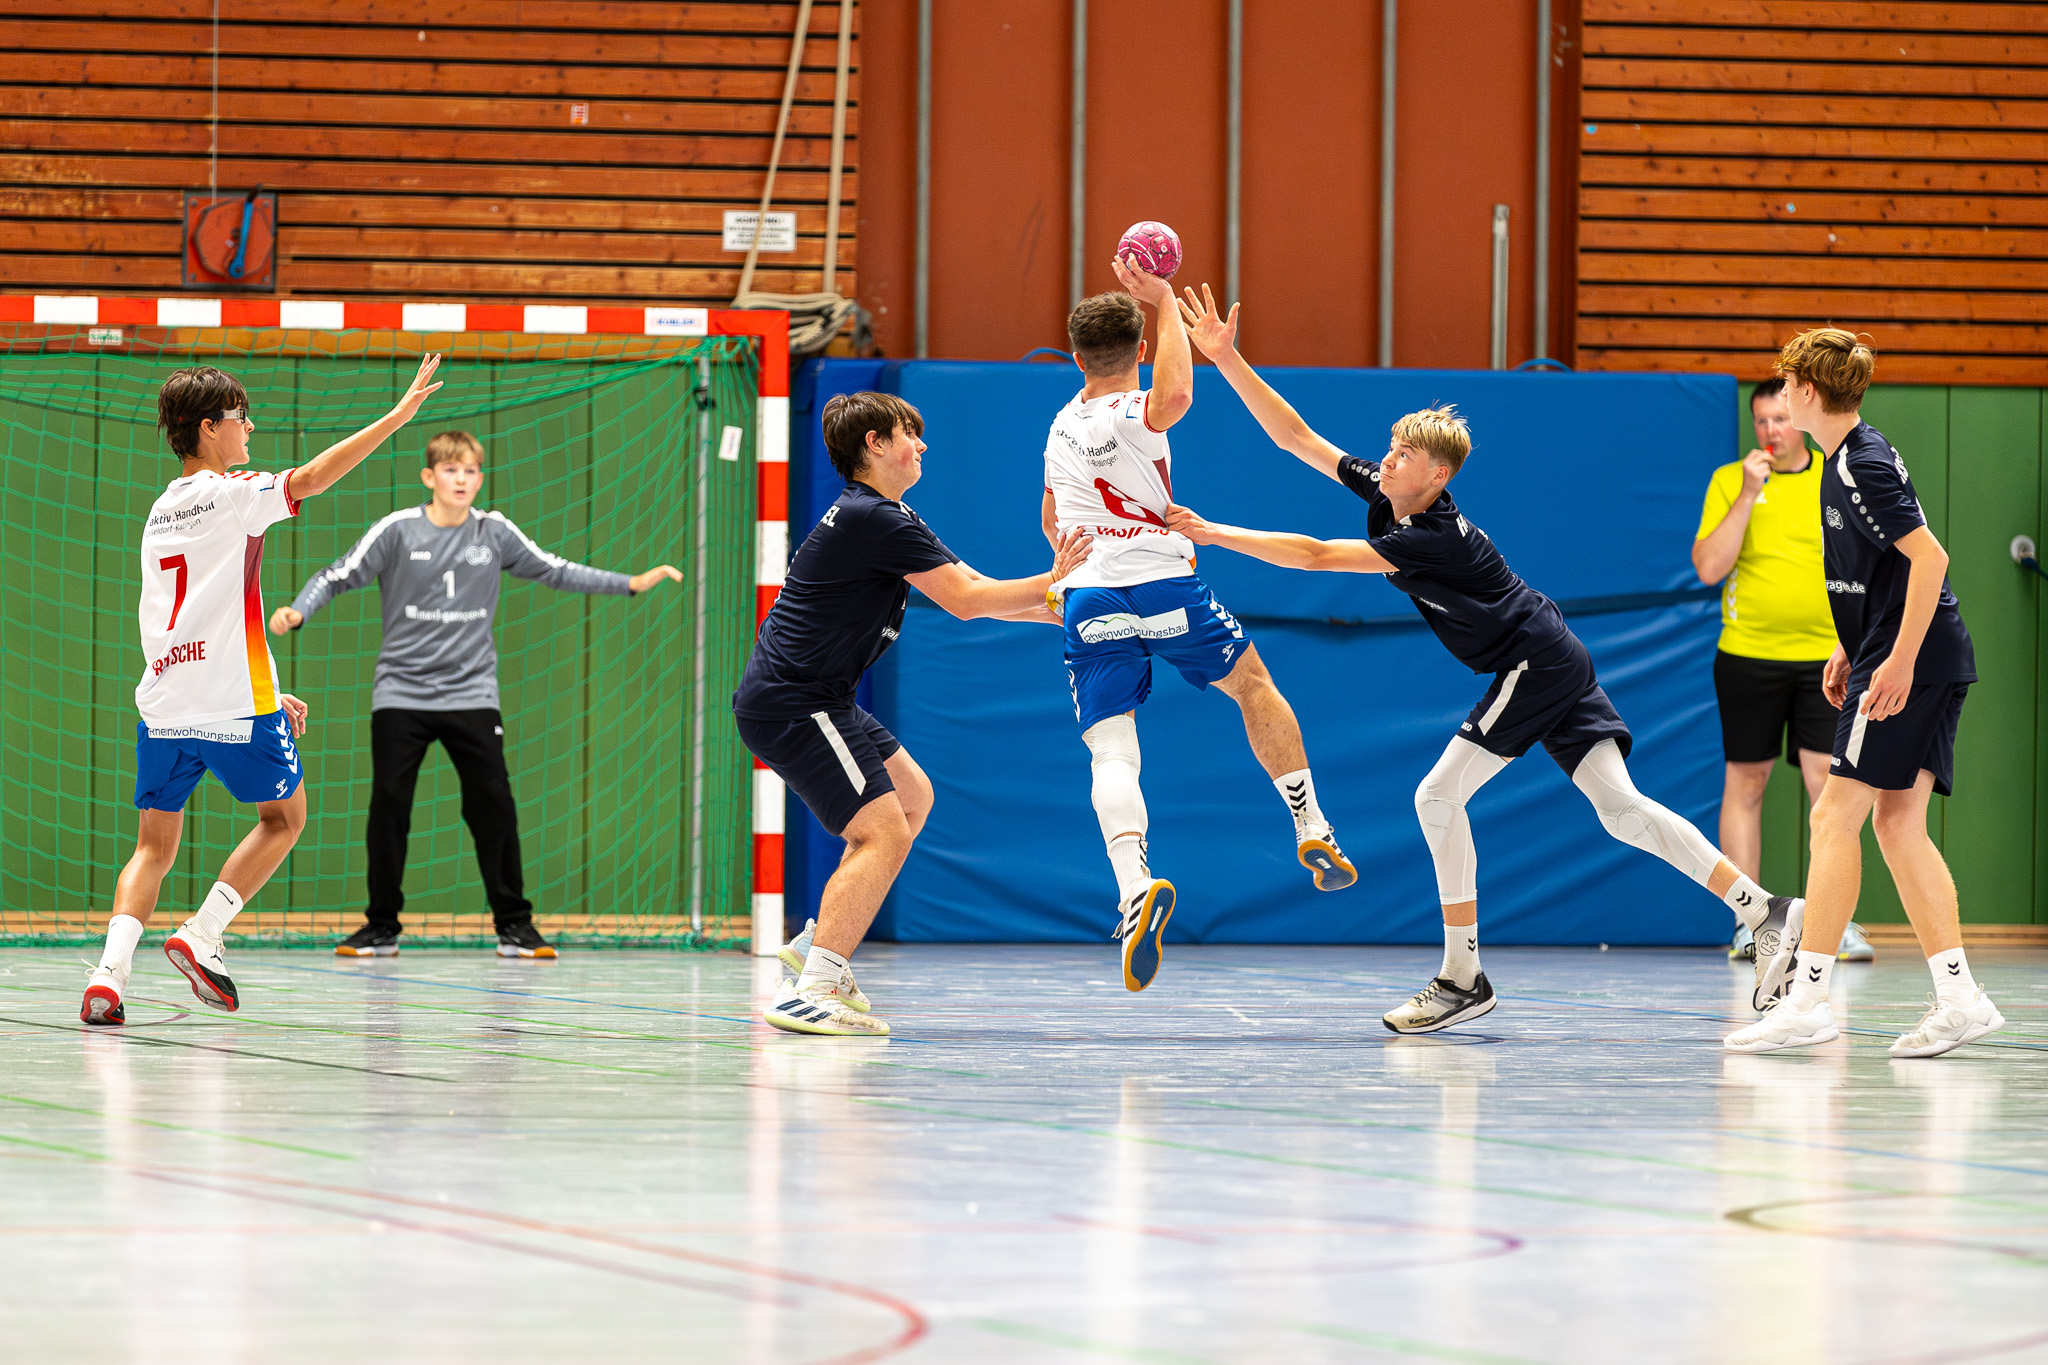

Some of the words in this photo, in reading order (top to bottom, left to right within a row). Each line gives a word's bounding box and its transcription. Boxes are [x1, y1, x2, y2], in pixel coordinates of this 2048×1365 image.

[159, 553, 188, 632] 7
[442, 570, 456, 599] 1
[1083, 624, 1188, 643] Rheinwohnungsbau
